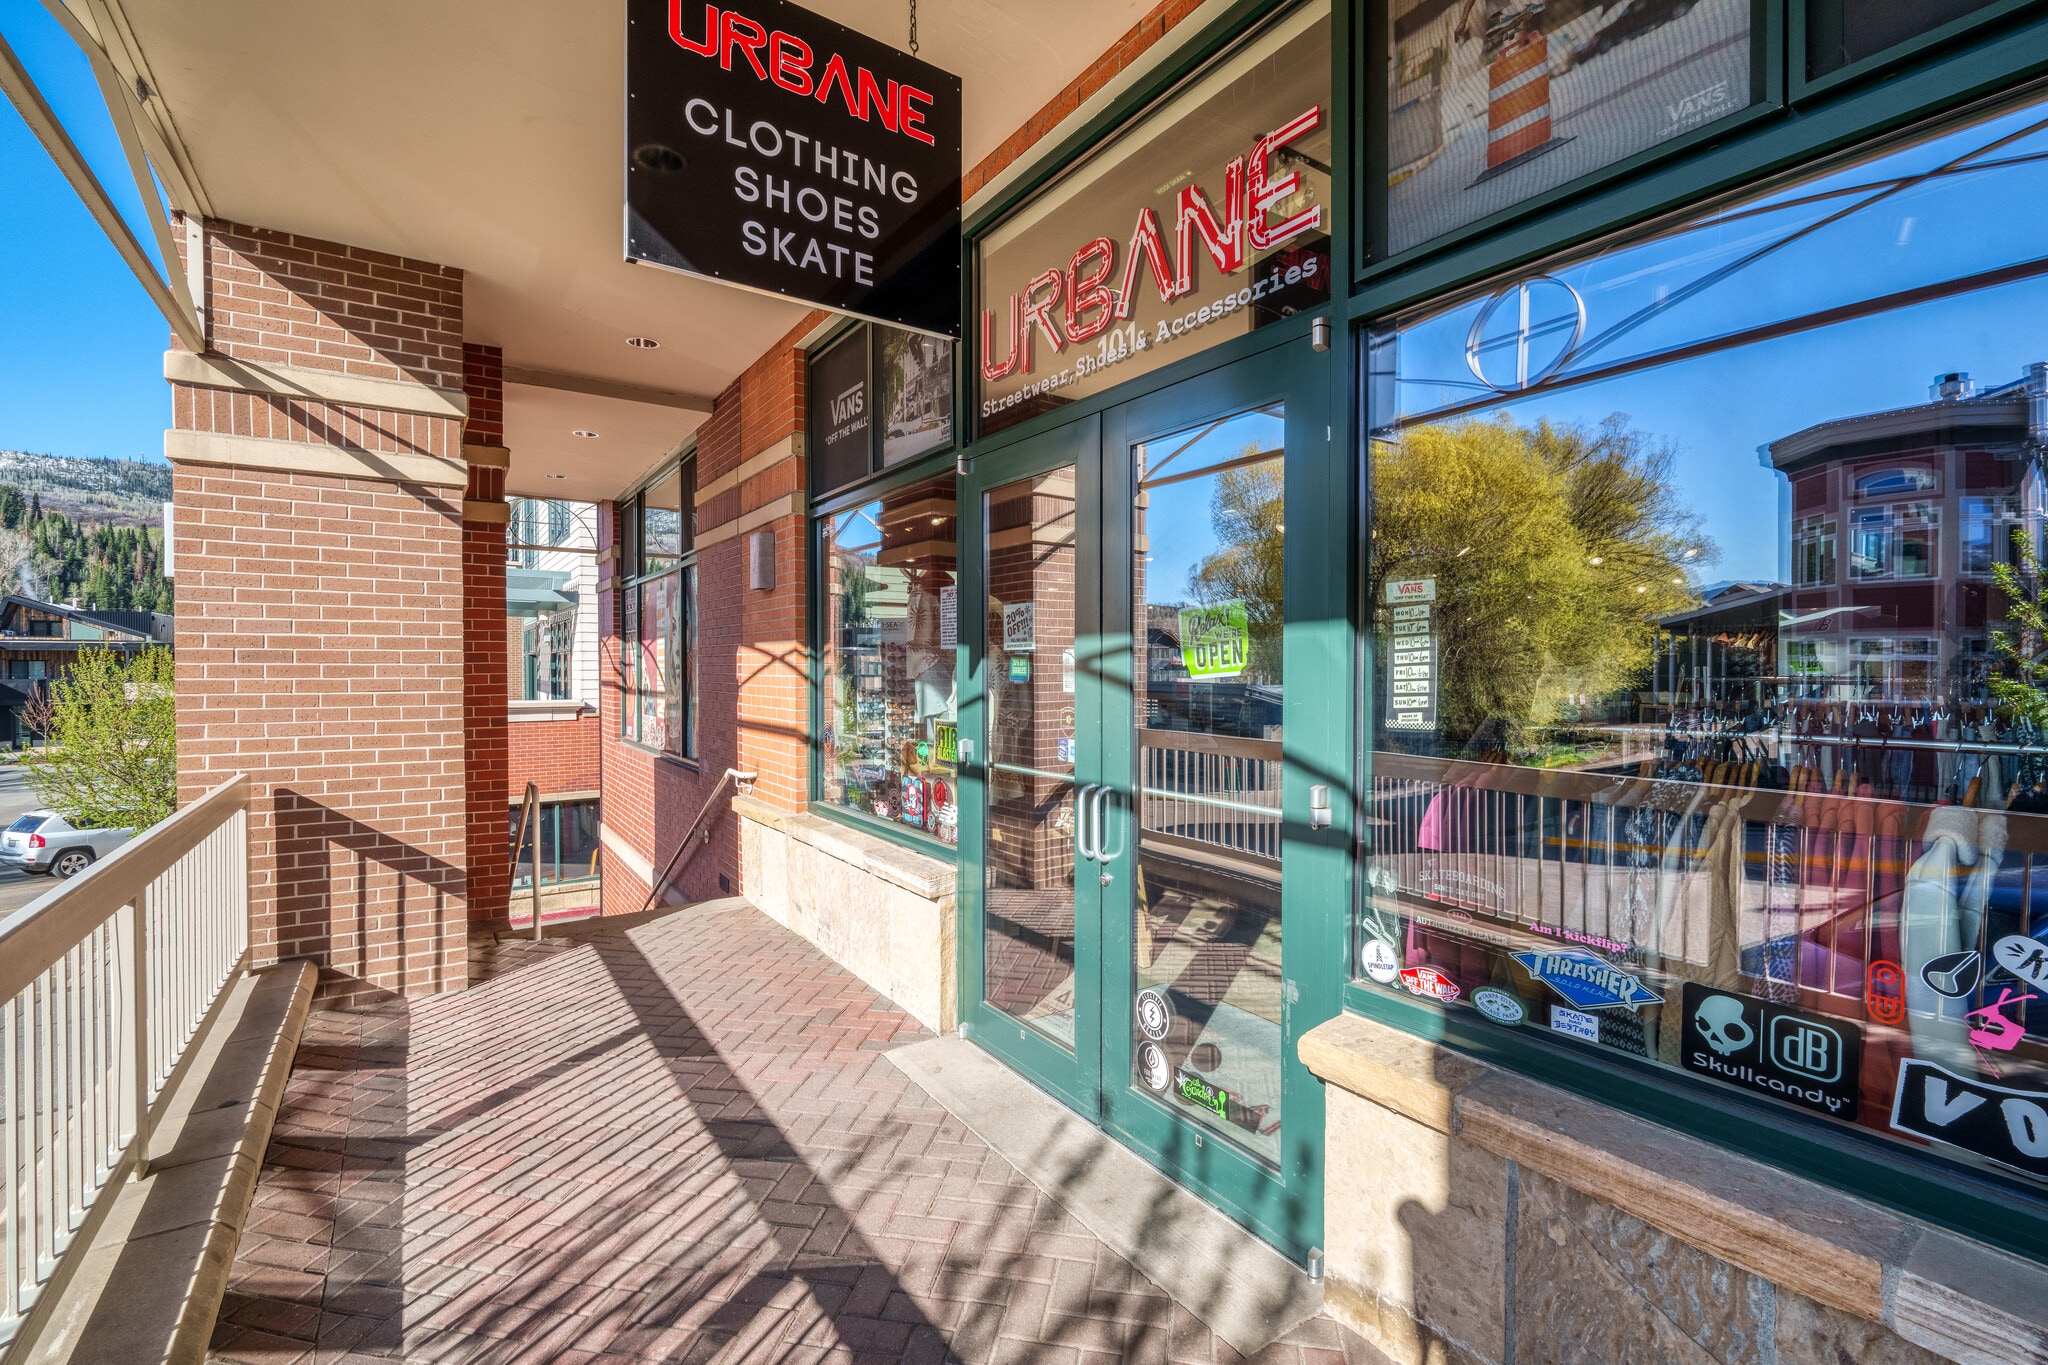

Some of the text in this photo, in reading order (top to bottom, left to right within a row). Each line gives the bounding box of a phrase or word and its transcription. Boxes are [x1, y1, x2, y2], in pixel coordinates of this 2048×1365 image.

[668, 0, 934, 146] URBANE
[1667, 80, 1727, 121] VANS
[685, 98, 918, 203] CLOTHING
[734, 166, 880, 239] SHOES
[742, 220, 874, 287] SKATE
[981, 104, 1320, 381] URBANE
[1075, 343, 1128, 377] Shoes
[1155, 256, 1318, 343] Accessories
[830, 380, 864, 426] VANS
[839, 425, 850, 440] THE
[1397, 582, 1424, 594] VANS
[1006, 607, 1024, 626] 20%
[1007, 617, 1029, 638] OFF!!!
[1188, 608, 1230, 646] Relax!
[1215, 628, 1242, 639] WE'RE
[1195, 639, 1244, 670] OPEN
[1418, 869, 1506, 899] SKATEBOARDING
[1434, 883, 1454, 894] SINCE
[1452, 911, 1468, 920] REAL
[1416, 916, 1508, 946] AUTHORIZED DEALER
[1529, 921, 1628, 953] Am I kickflip?
[1368, 962, 1394, 970] SPINDLETAP
[1416, 968, 1438, 982] VANS
[1531, 949, 1638, 1009] THRASHER
[1420, 978, 1435, 992] THE
[1554, 1020, 1596, 1038] DESTROY
[1558, 1010, 1594, 1024] SKATE
[1784, 1027, 1828, 1072] dB
